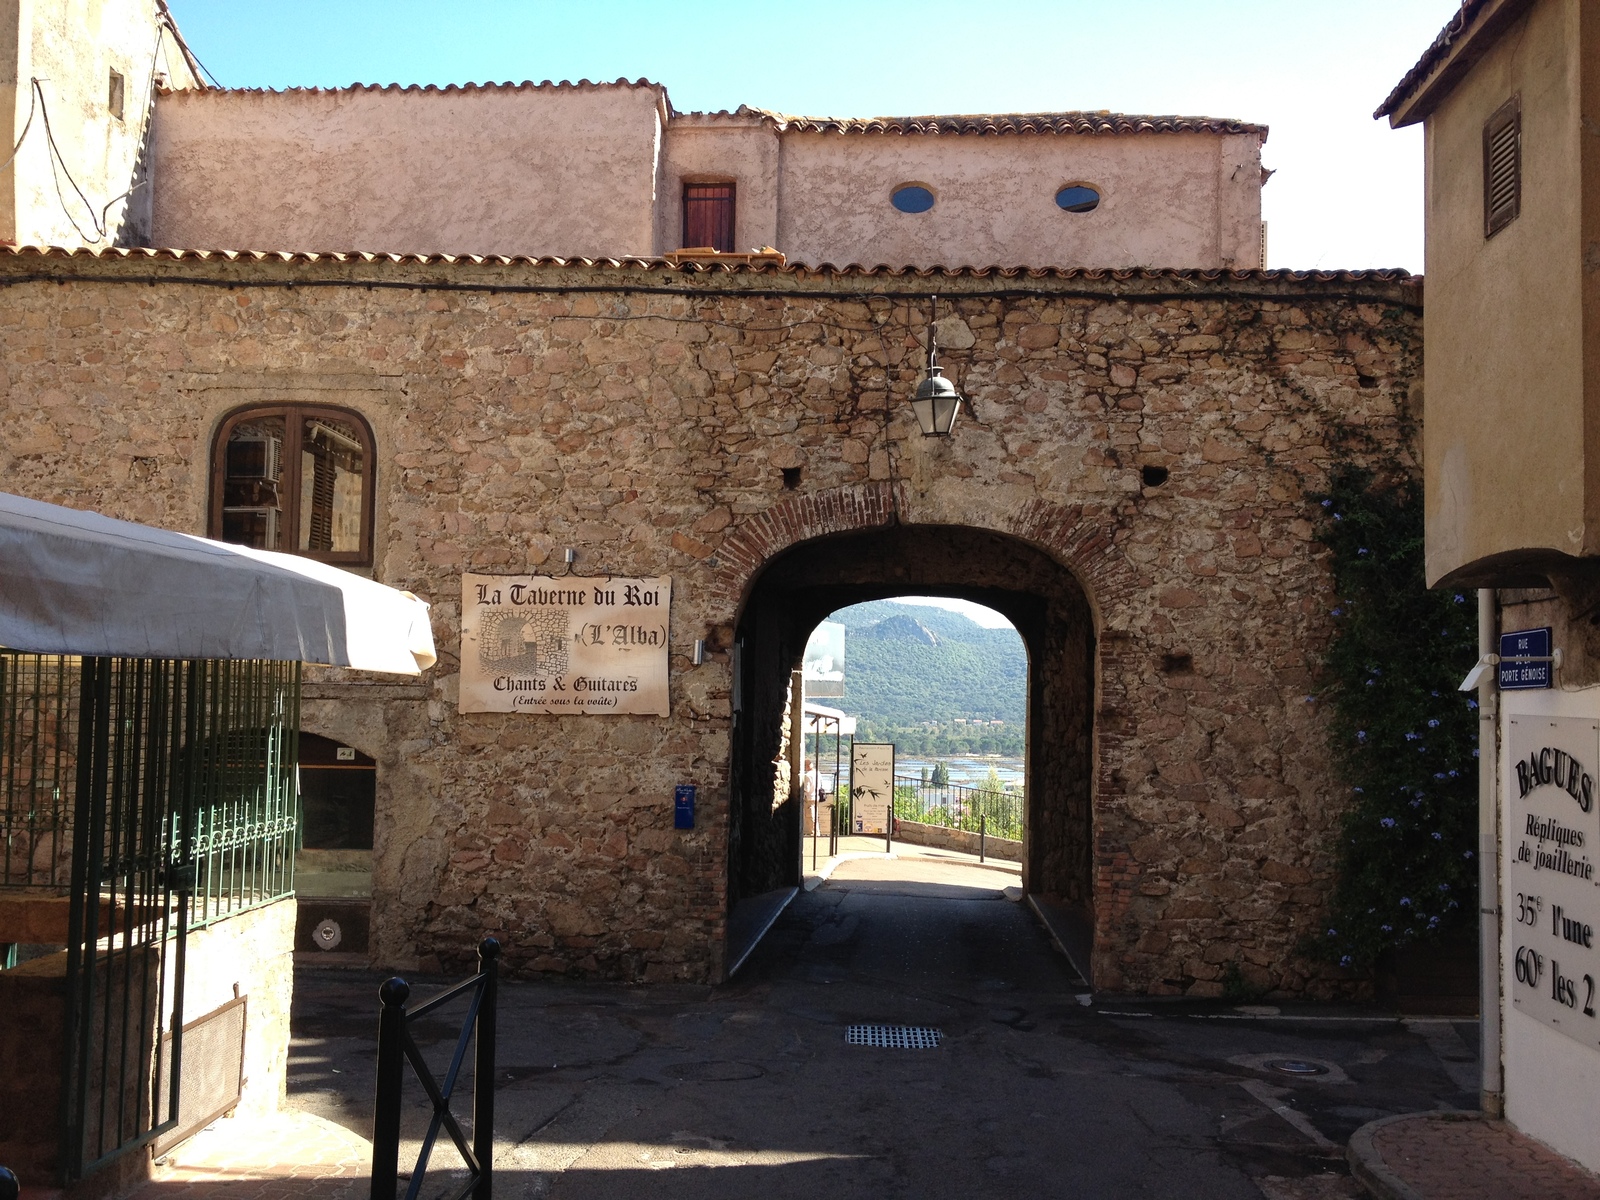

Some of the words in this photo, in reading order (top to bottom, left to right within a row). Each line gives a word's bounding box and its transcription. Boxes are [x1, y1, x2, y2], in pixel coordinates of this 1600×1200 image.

[475, 584, 501, 606] La
[510, 584, 586, 606] Taverne
[593, 586, 616, 606] du
[623, 585, 660, 607] Roi
[581, 622, 667, 649] (L'Alba)
[1517, 638, 1529, 649] RUE
[493, 676, 546, 693] Chants
[552, 676, 566, 691] &
[573, 676, 638, 693] Guitares
[1501, 669, 1519, 682] PORTE
[1521, 665, 1546, 680] GÉNOISE
[512, 696, 547, 707] (Entrée
[549, 697, 571, 706] sous
[573, 696, 584, 706] la
[587, 696, 618, 708] voûte)
[1515, 747, 1593, 812] BAGUES
[1525, 813, 1585, 848] Répliques
[1518, 840, 1531, 863] de
[1533, 844, 1593, 880] joaillerie
[1552, 904, 1592, 949] l'une
[1551, 960, 1576, 1009] les
[1583, 974, 1595, 1017] 2
